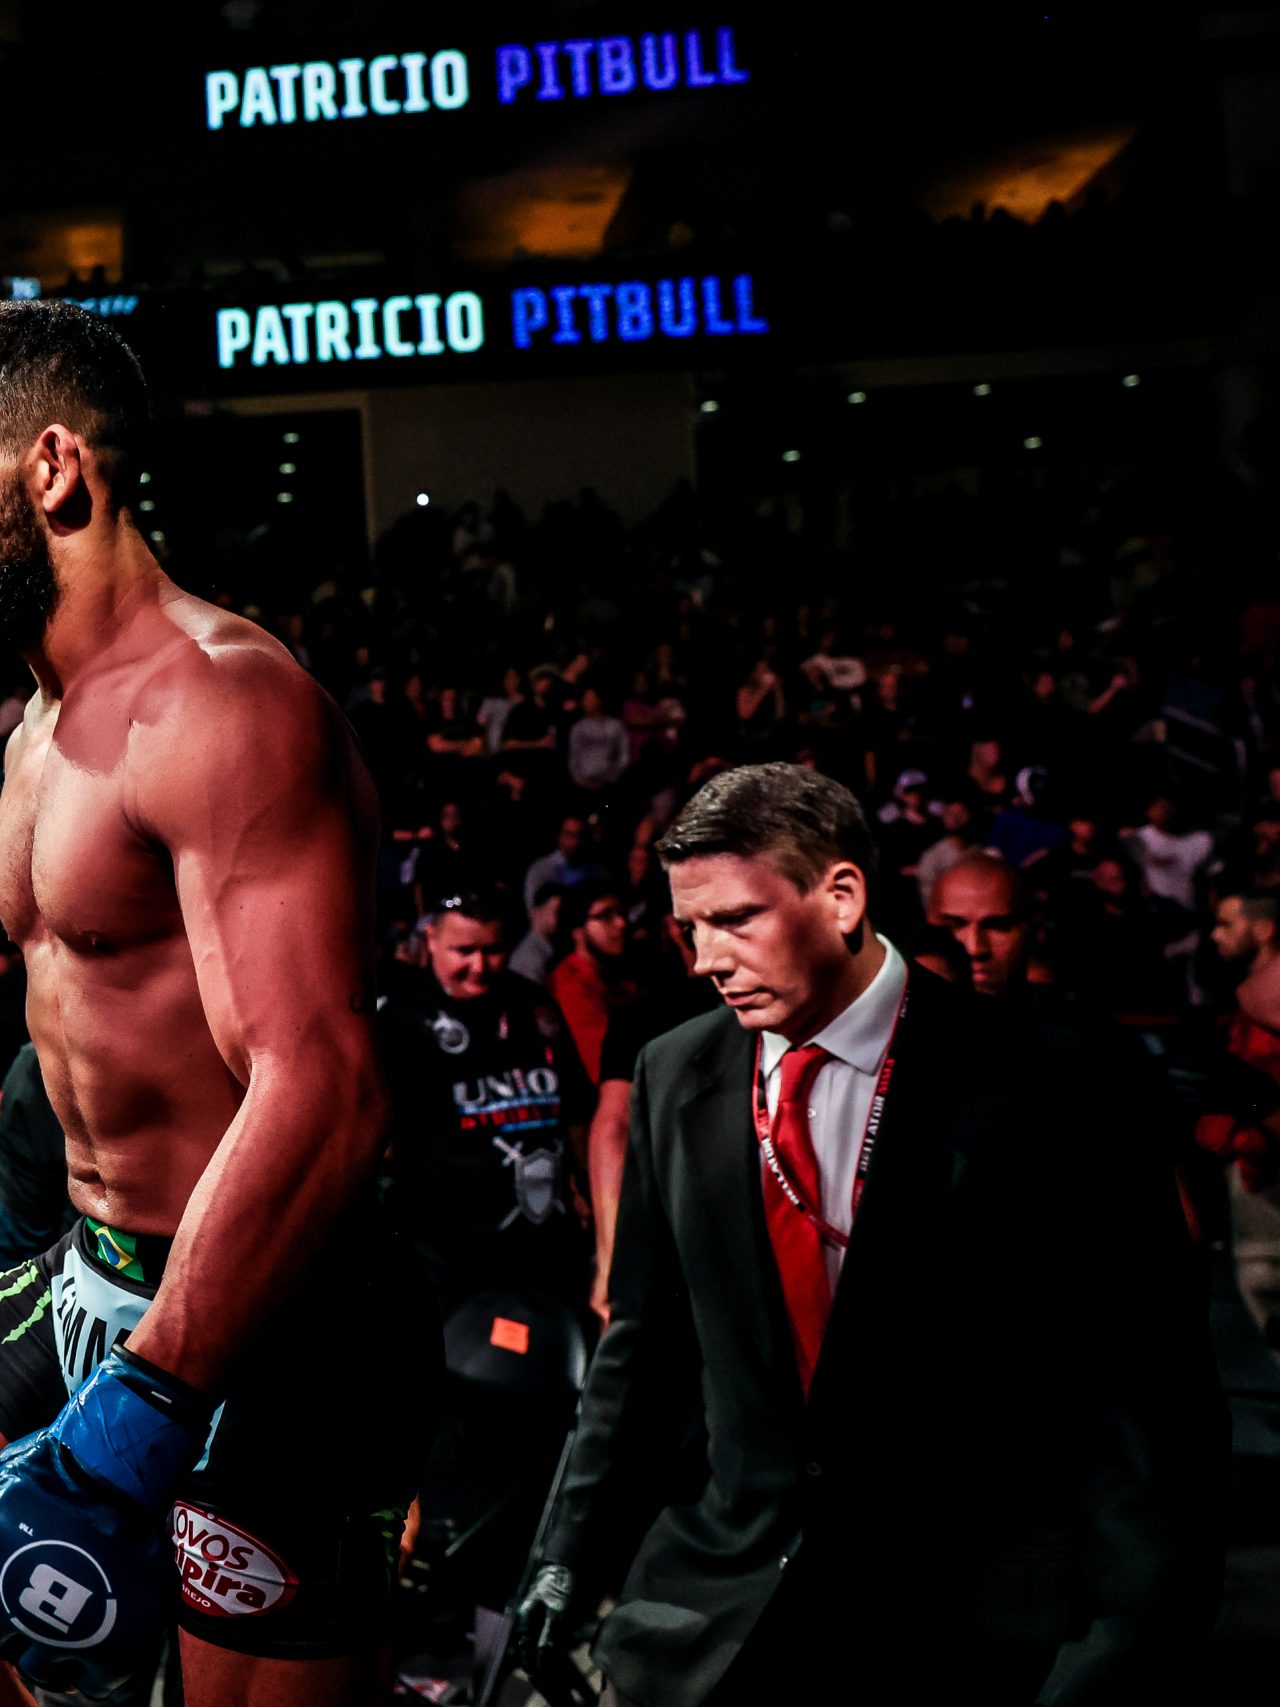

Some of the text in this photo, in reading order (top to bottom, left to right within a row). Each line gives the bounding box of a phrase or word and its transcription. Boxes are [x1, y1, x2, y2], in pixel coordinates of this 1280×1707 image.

[205, 27, 749, 130] PATRICIO PITBULL
[216, 275, 768, 368] PATRICIO PITBULL
[176, 1542, 267, 1609] ipira
